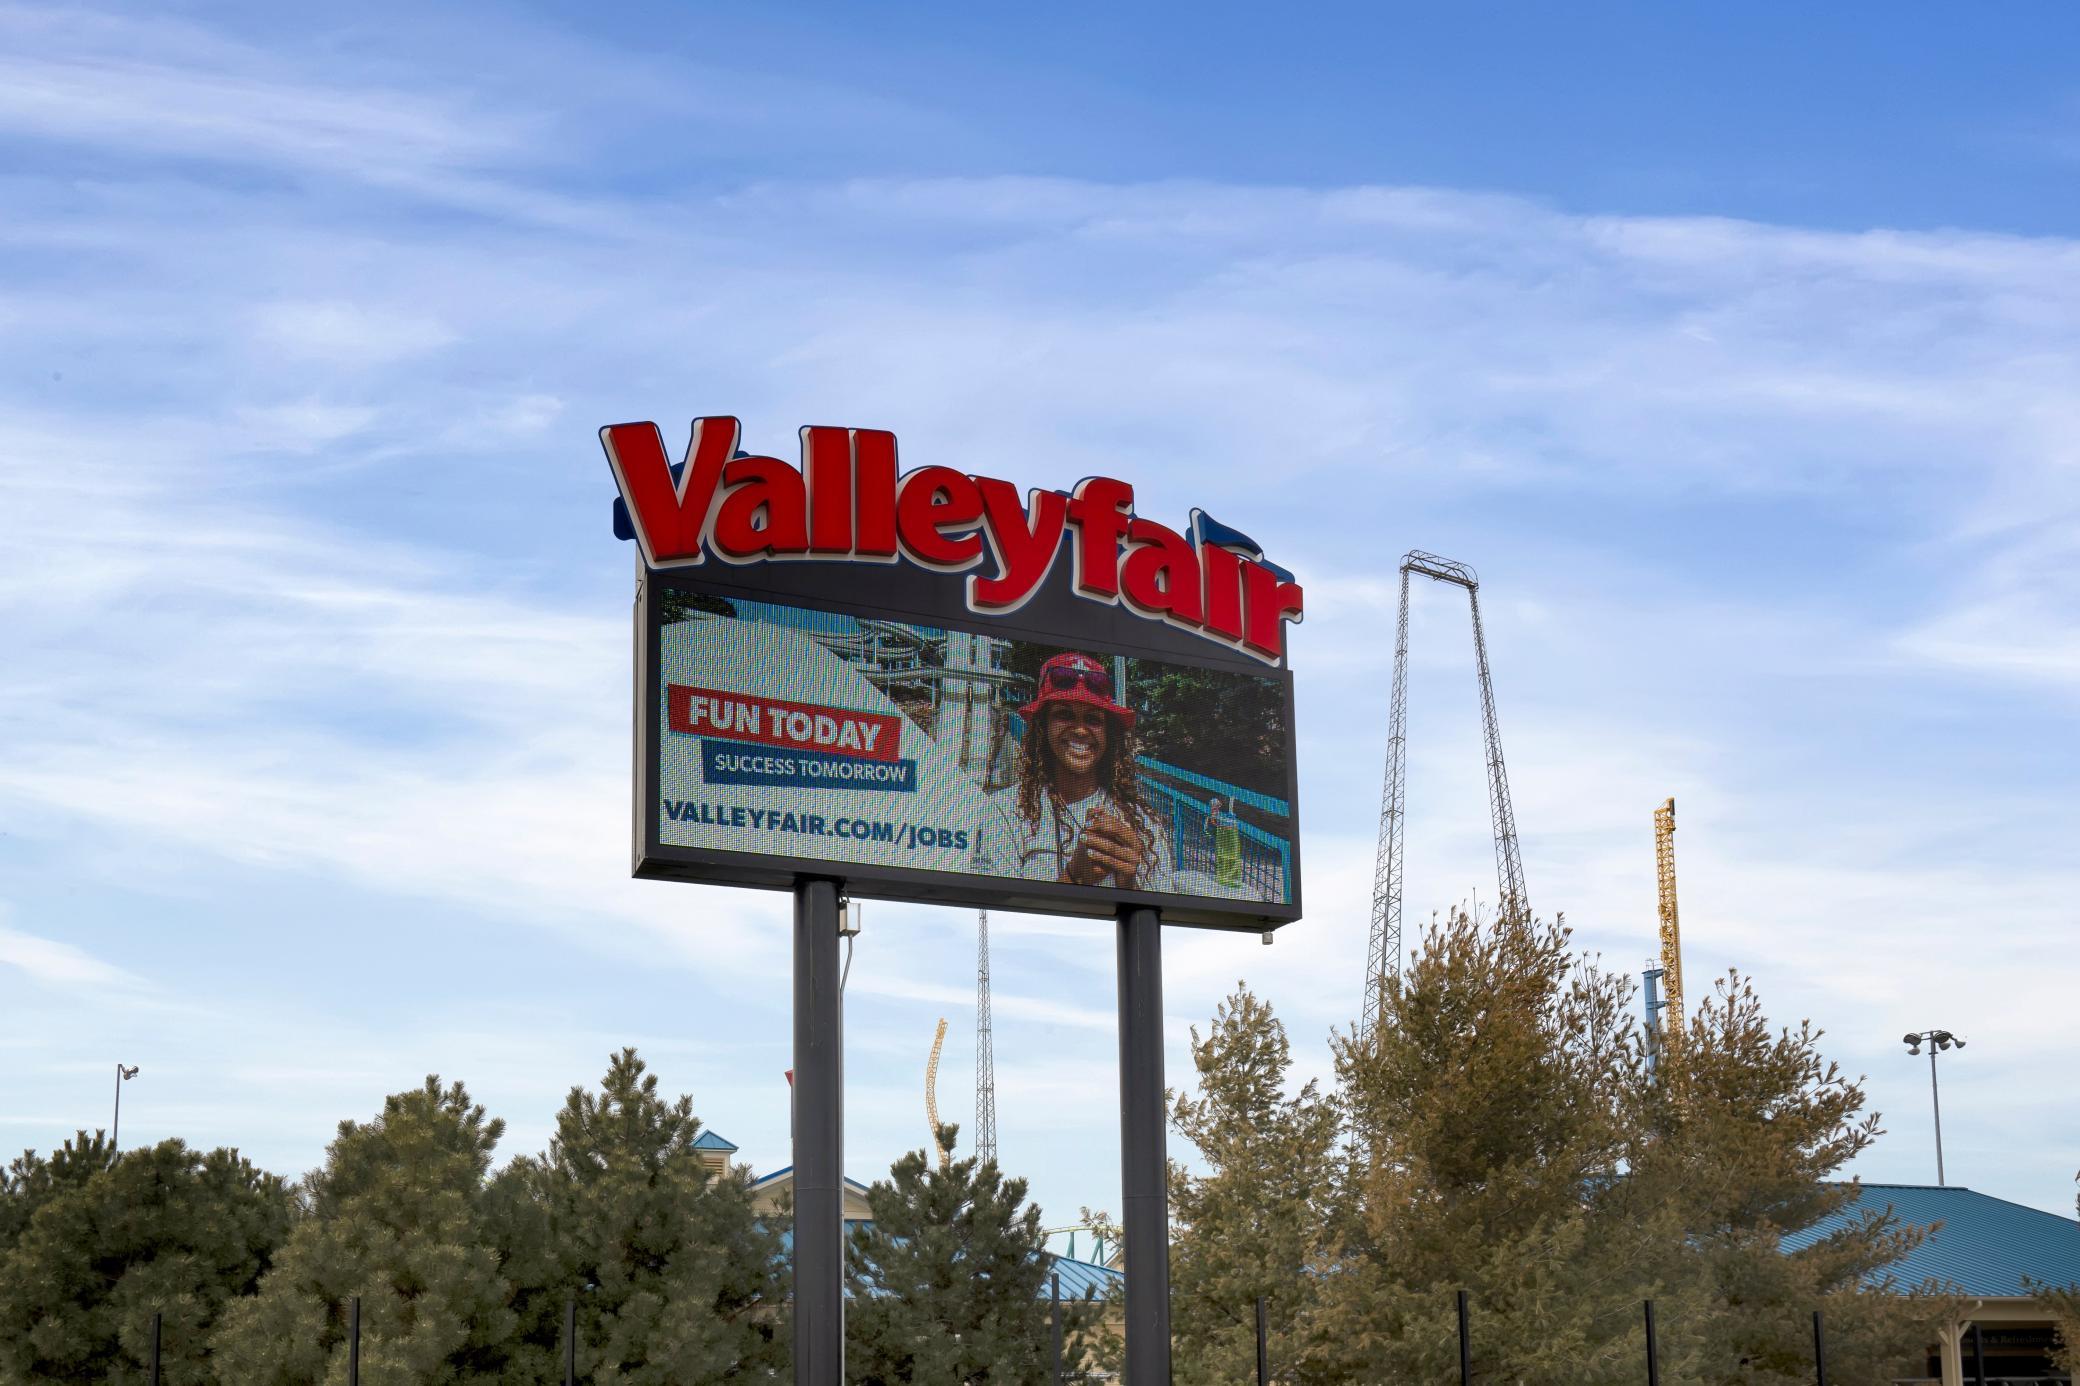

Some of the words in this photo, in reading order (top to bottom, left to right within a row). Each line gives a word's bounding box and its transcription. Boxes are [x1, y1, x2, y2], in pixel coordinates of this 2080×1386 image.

[602, 416, 1302, 666] Valleyfair
[689, 695, 760, 735] FUN
[768, 707, 881, 752] TODAY
[715, 753, 796, 776] SUCCESS
[798, 759, 907, 783] TOMORROW
[663, 798, 968, 850] VALLEYFAIR.COM/JOBS
